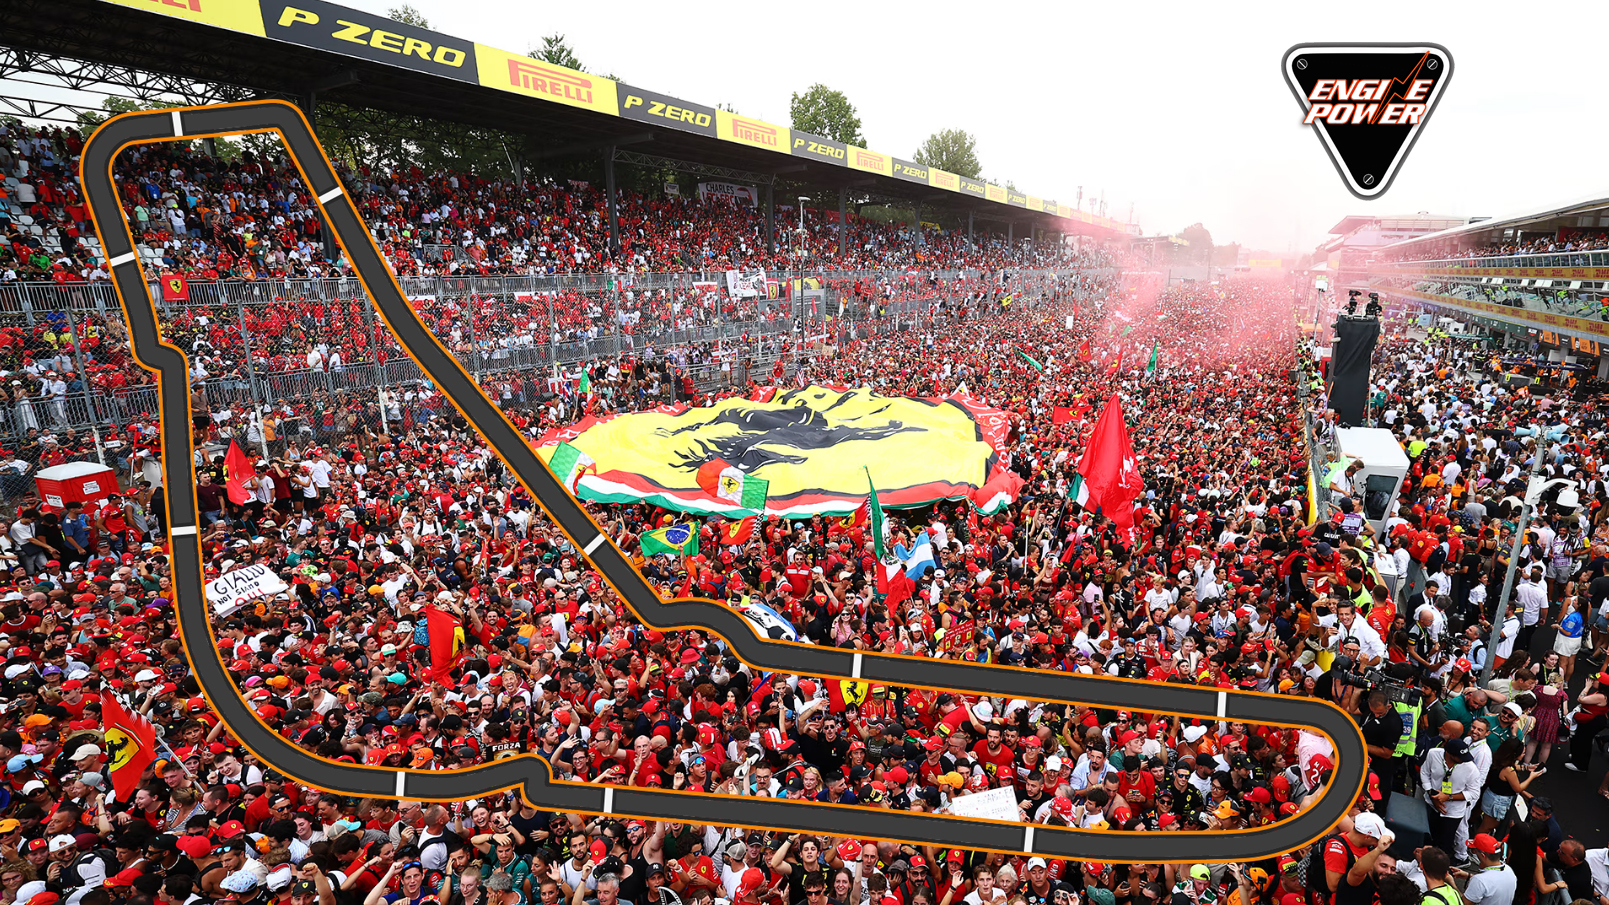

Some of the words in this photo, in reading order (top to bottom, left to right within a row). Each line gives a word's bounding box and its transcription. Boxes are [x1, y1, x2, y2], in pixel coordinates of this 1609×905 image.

[278, 6, 320, 27] P
[331, 20, 466, 68] ZERO
[507, 58, 593, 104] PIRELLI
[624, 95, 643, 108] P
[647, 100, 712, 128] ZERO
[732, 118, 777, 146] PIRELLI
[793, 138, 805, 149] P
[807, 141, 845, 160] ZERO
[856, 151, 884, 171] PIRELLI
[894, 163, 902, 172] P
[902, 165, 927, 179] ZERO
[705, 182, 735, 195] CHARLES
[935, 172, 954, 188] PIRELLI
[966, 183, 985, 194] ZERO
[214, 564, 265, 595] GIALLU
[217, 594, 232, 605] NOI
[235, 581, 260, 596] SIAMO
[492, 742, 521, 752] FORZA
